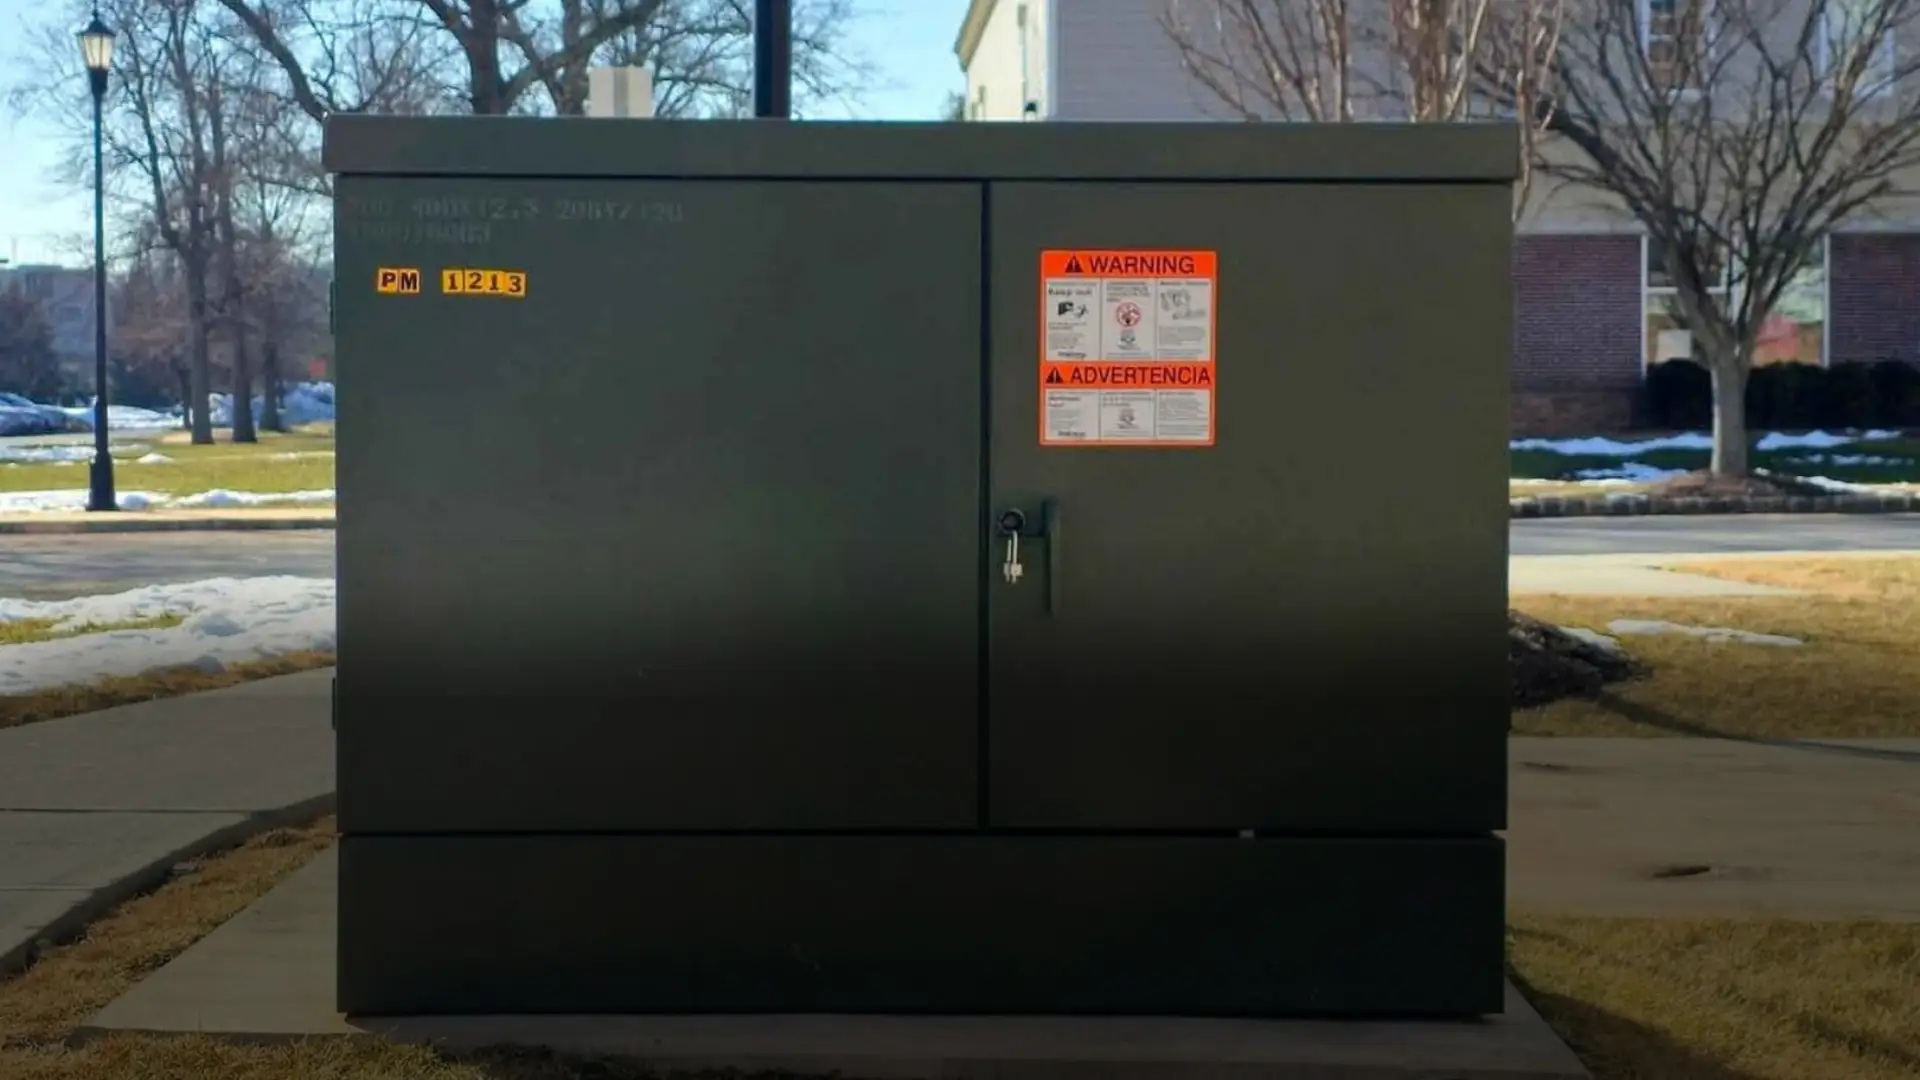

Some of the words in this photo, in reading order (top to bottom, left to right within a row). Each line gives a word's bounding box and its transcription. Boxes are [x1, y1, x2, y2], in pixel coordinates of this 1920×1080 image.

[1089, 256, 1195, 274] WARNING
[381, 272, 417, 290] PM
[448, 272, 522, 293] 1213
[1070, 366, 1211, 385] ADVERTENCIA
